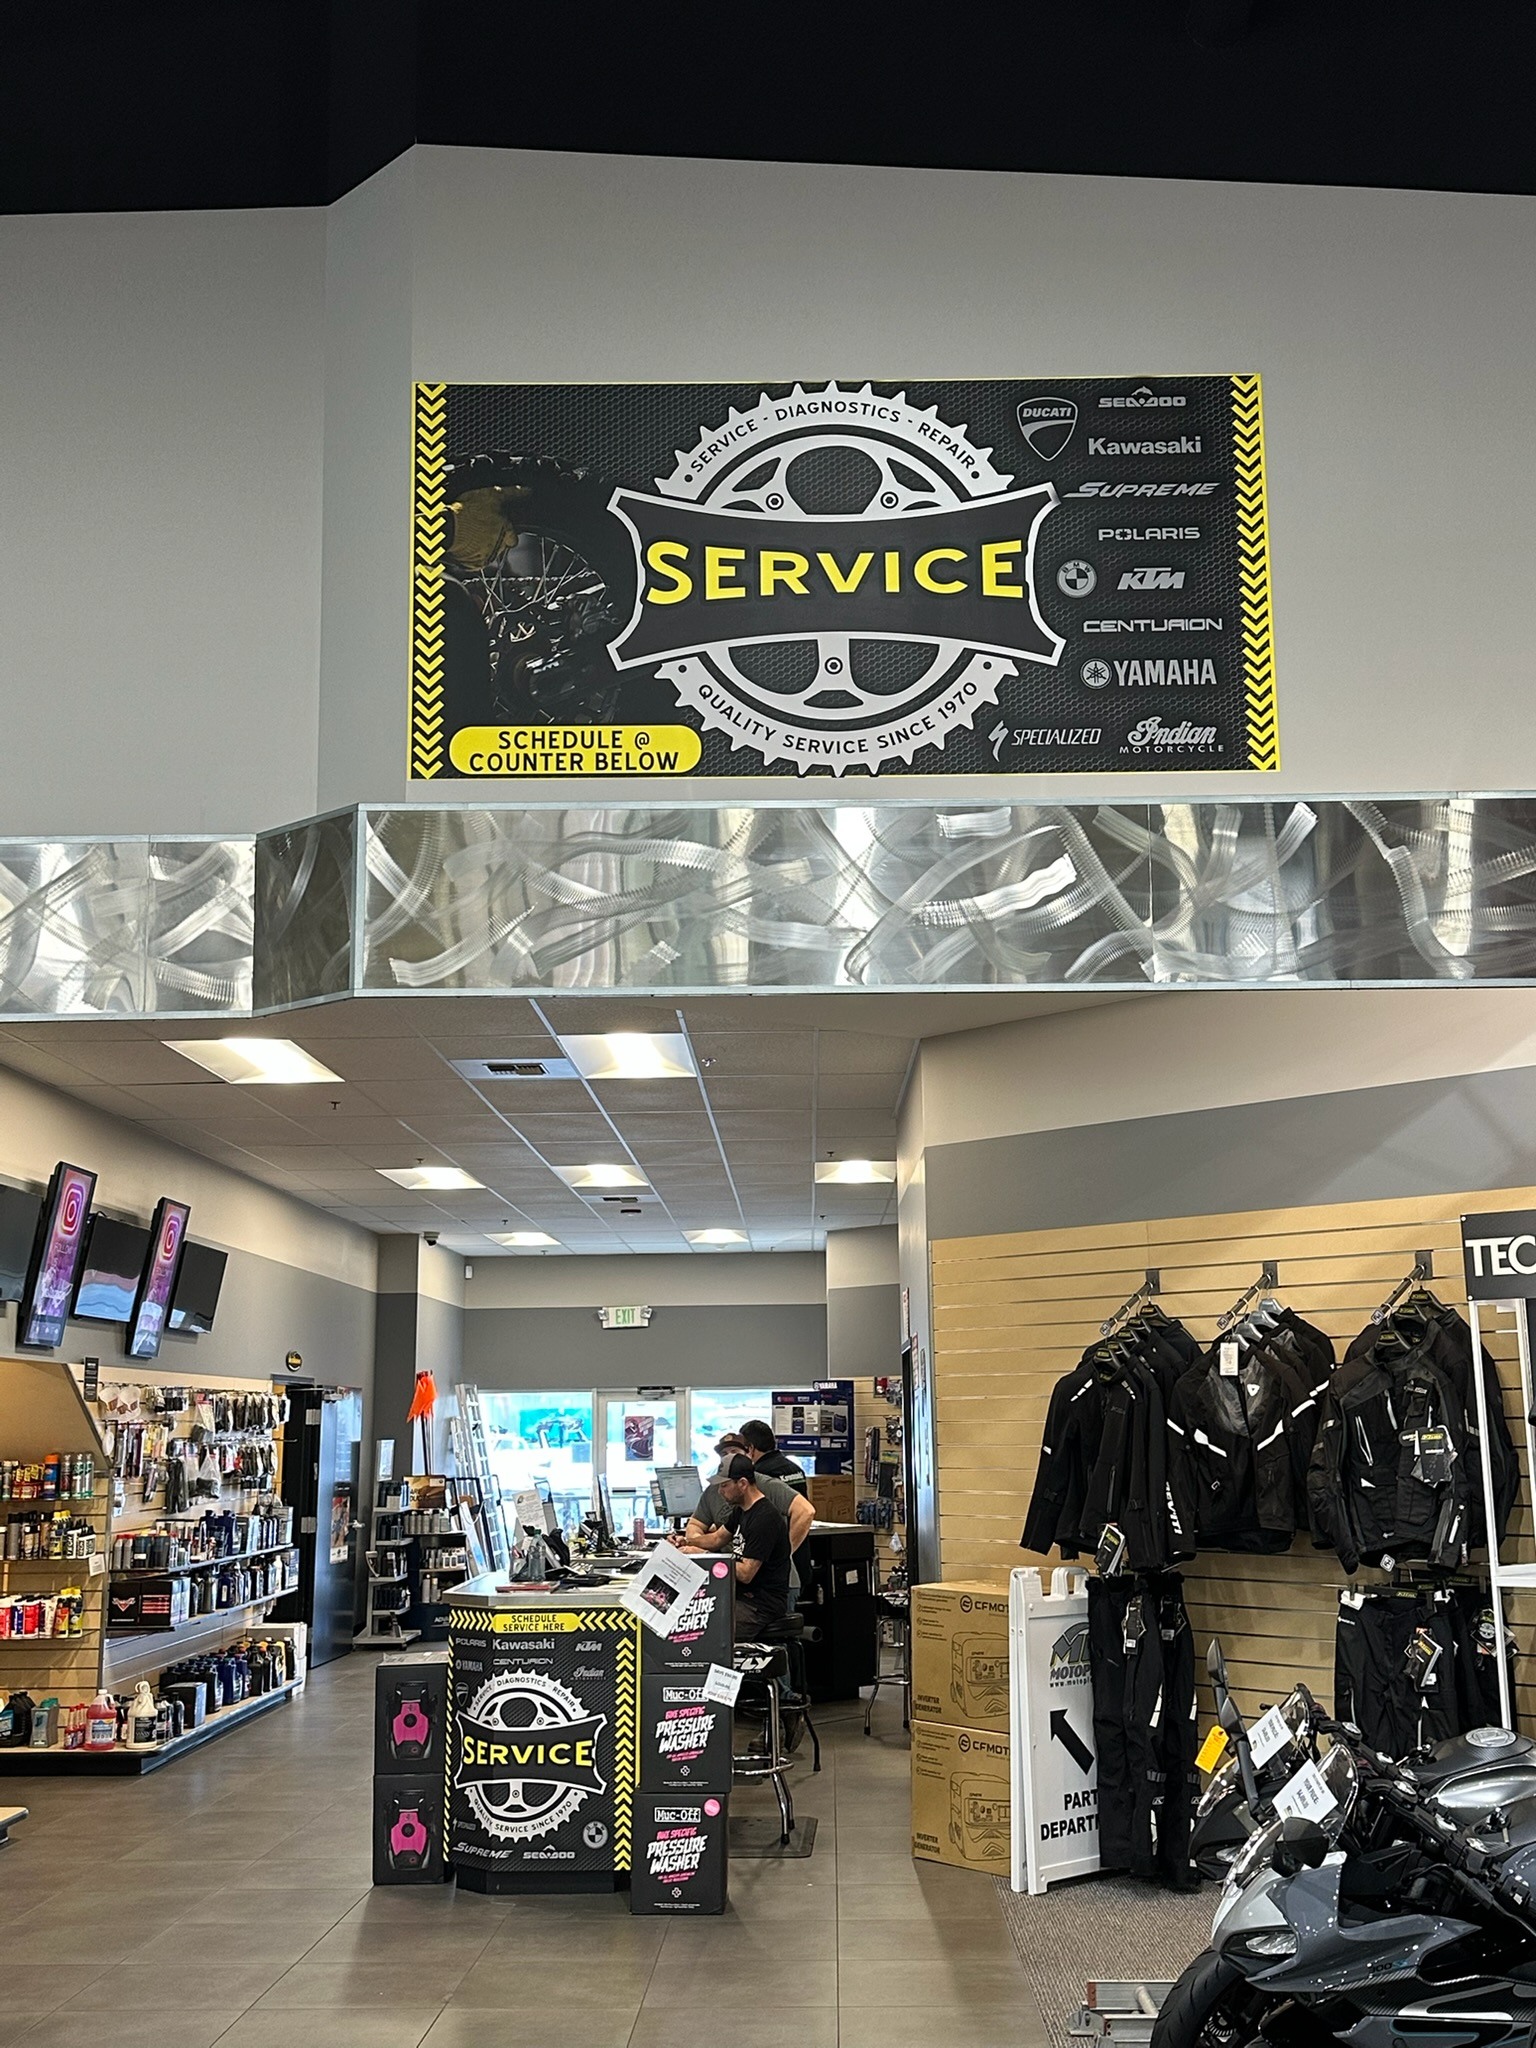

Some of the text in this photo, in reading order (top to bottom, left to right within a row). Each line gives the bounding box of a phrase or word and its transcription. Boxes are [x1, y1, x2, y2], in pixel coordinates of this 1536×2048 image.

[1022, 407, 1073, 419] DUCATI
[690, 400, 976, 474] SERVICE DIAGNOSTICS REPAIR
[1088, 436, 1202, 455] Kawasaki
[1063, 481, 1221, 498] SUPREME
[1098, 526, 1201, 541] POLARIS
[646, 540, 1024, 606] SERVICE
[1116, 567, 1186, 591] KTM
[1083, 618, 1223, 633] CENTURION
[1113, 658, 1218, 686] YAMAHA
[698, 681, 978, 754] QUALITY SERVICE SINCE 1970
[498, 730, 650, 749] SCHEDULE @
[1012, 728, 1102, 746] SPECIALIZED
[1127, 716, 1218, 746] Indian
[1119, 744, 1224, 754] MOTORCYCLE
[469, 752, 679, 771] COUNTER BELOW
[1465, 1234, 1536, 1277] TEC
[615, 1308, 636, 1325] EXIT
[683, 1597, 716, 1614] SURE
[503, 1623, 565, 1632] SERVICE HERE
[511, 1614, 557, 1623] SCHEDULE
[670, 1613, 710, 1634] ASHER
[455, 1637, 487, 1648] POLARIS
[492, 1638, 555, 1650] Kawasaki
[575, 1640, 602, 1651] KTM
[493, 1658, 553, 1666] CENTURION
[496, 1677, 547, 1688] DIAGNOSTICS
[552, 1686, 576, 1708] REPAIR
[665, 1689, 705, 1700] Muc-Of
[655, 1714, 716, 1739] PRESSURE
[463, 1735, 593, 1767] SERVICE
[658, 1731, 709, 1754] WASHER
[1064, 1789, 1098, 1811] PART
[473, 1798, 493, 1827] QUALITY
[494, 1823, 529, 1833] SERVICE
[531, 1817, 555, 1831] SINCE
[555, 1801, 572, 1818] 1970
[657, 1809, 699, 1821] Muc-Off
[452, 1841, 513, 1859] SUPREME
[646, 1835, 708, 1859] PRESSURE
[649, 1853, 701, 1875] WASHER
